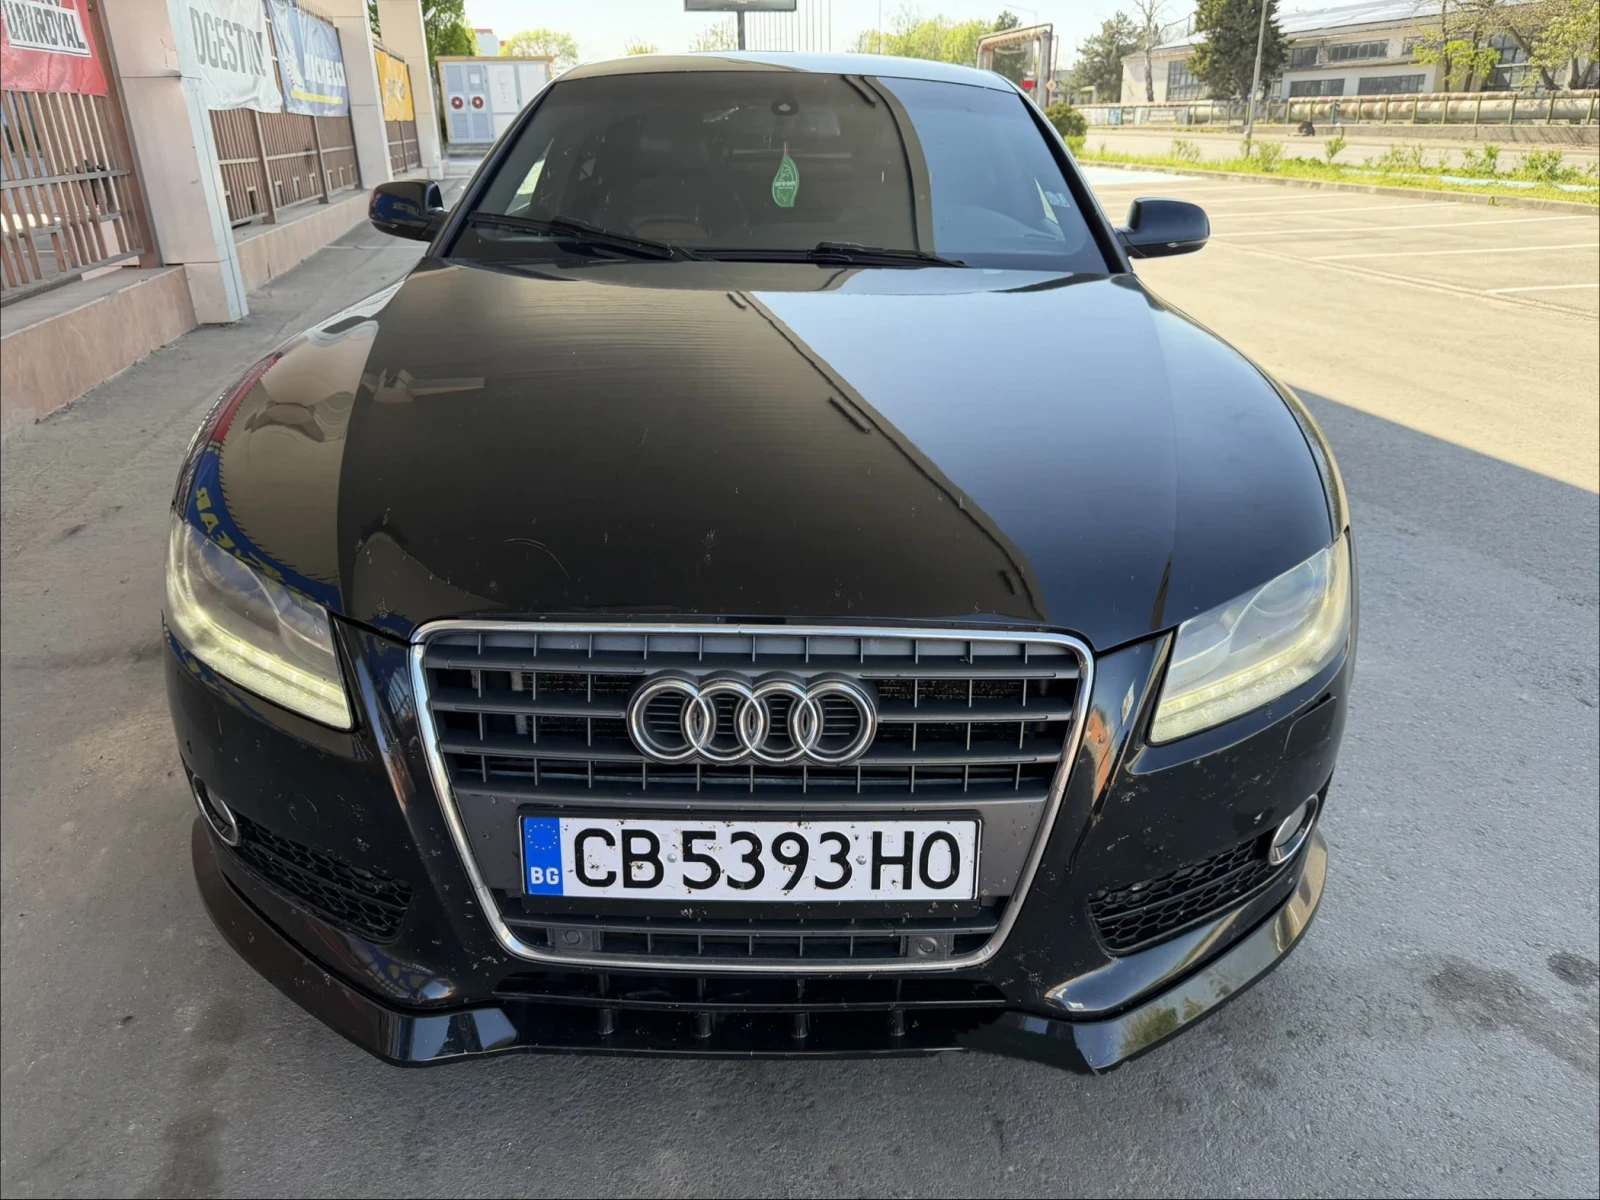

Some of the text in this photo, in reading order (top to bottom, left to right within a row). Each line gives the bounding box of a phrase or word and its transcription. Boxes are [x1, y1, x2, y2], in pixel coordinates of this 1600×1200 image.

[2, 1, 87, 49] UNIROYAL
[530, 867, 560, 885] BG
[574, 827, 664, 889] CB
[682, 830, 853, 891] 5393
